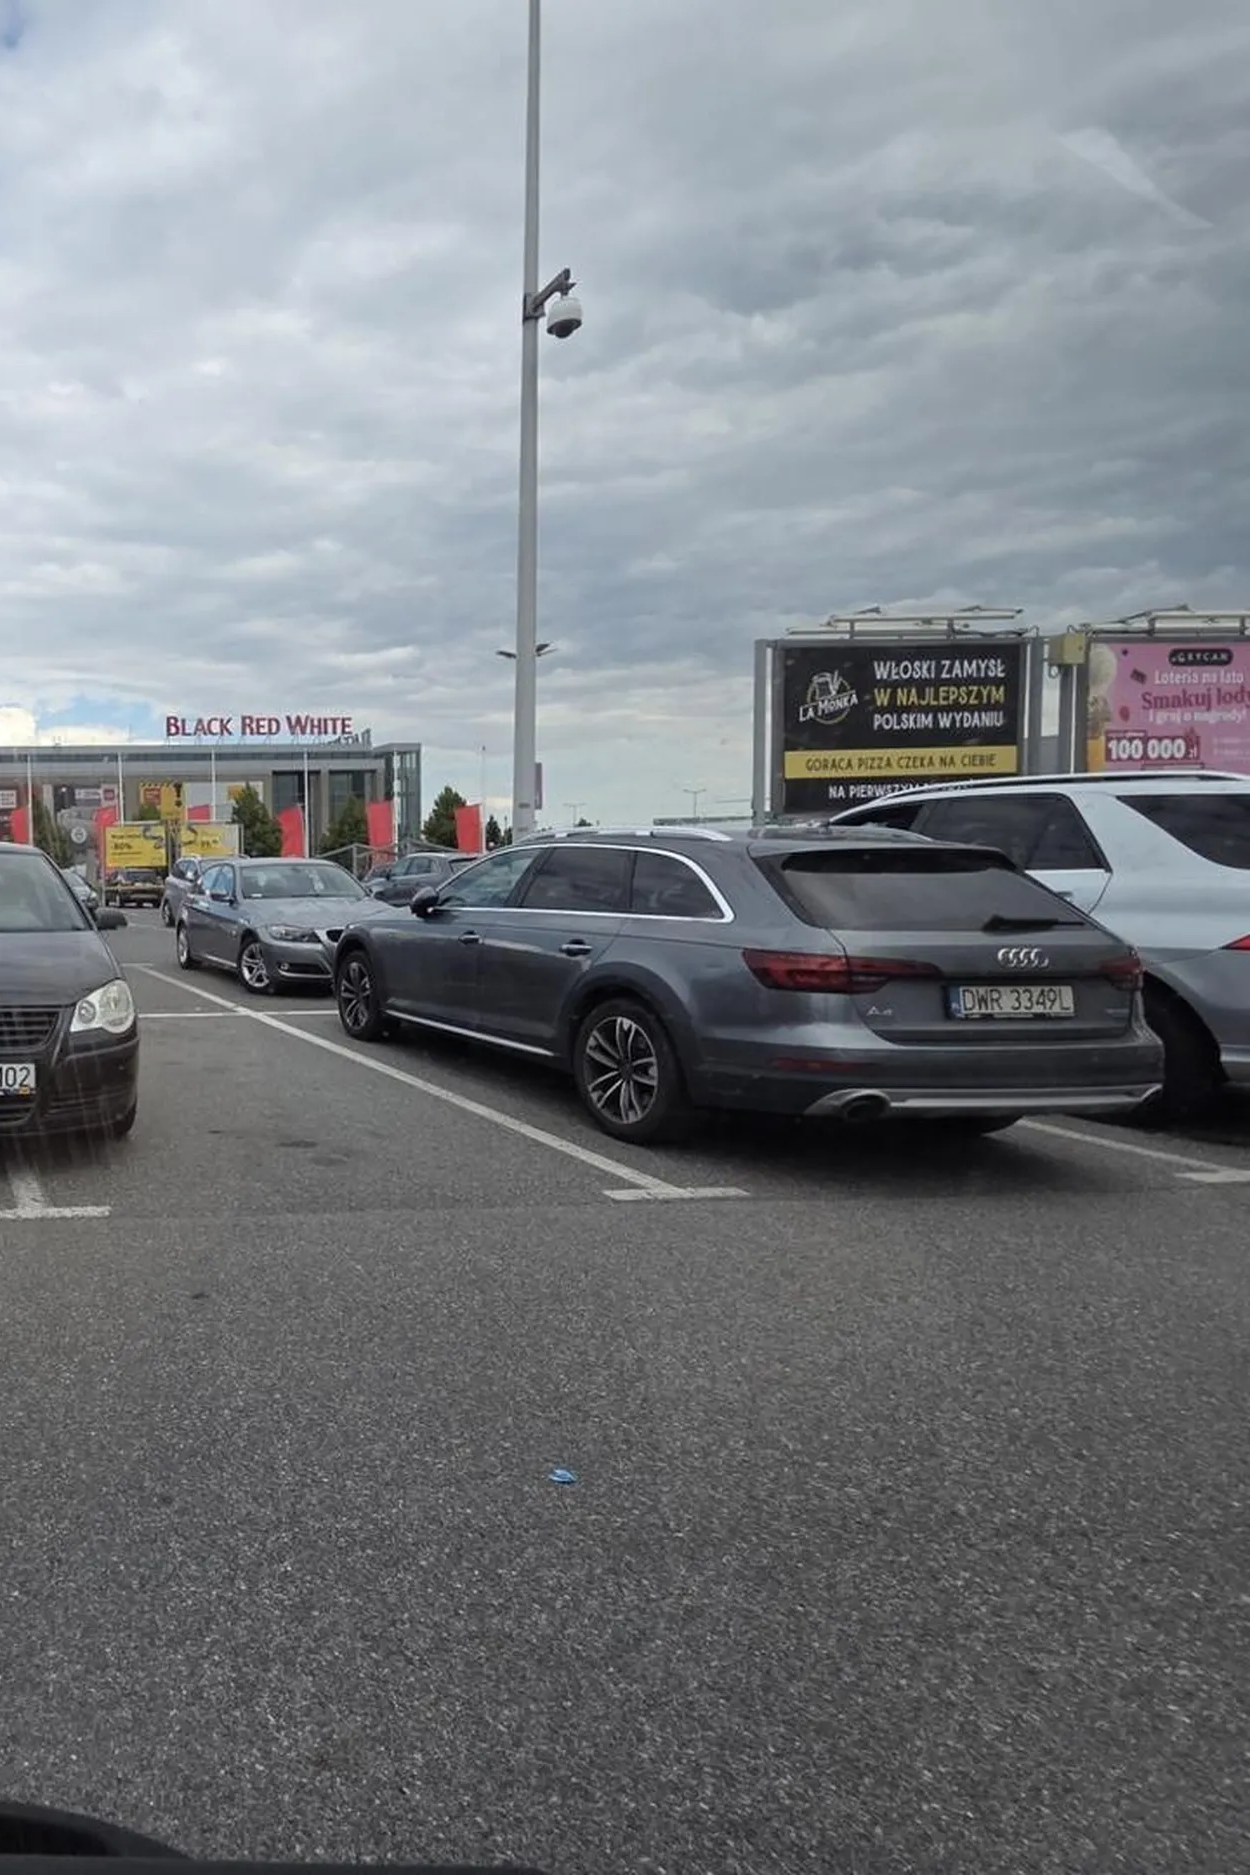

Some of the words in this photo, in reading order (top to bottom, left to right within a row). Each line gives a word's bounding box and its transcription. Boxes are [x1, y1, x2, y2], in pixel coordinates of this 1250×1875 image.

[873, 660, 936, 680] WŁOSKI
[940, 658, 1006, 678] ZAMYSŁ
[1154, 668, 1199, 685] Loteria
[873, 687, 892, 707] W
[896, 684, 1006, 706] NAJLEPSZYM
[1141, 687, 1212, 711] Smakuj
[799, 705, 815, 723] LA
[873, 711, 934, 731] POLSKIM
[937, 710, 1004, 729] WYDANIU
[165, 715, 234, 737] BLACK
[240, 715, 281, 736] RED
[285, 714, 353, 736] WHITE
[1107, 738, 1143, 760] 100
[1146, 738, 1186, 760] 000
[805, 757, 853, 773] GORĄCA
[857, 756, 893, 771] PIZZA
[896, 754, 935, 769] CZEKA
[940, 754, 956, 768] NA
[960, 753, 997, 767] CIEBIE
[828, 784, 847, 800] NA
[961, 988, 1003, 1011] DWR
[1010, 987, 1072, 1011] 3349L
